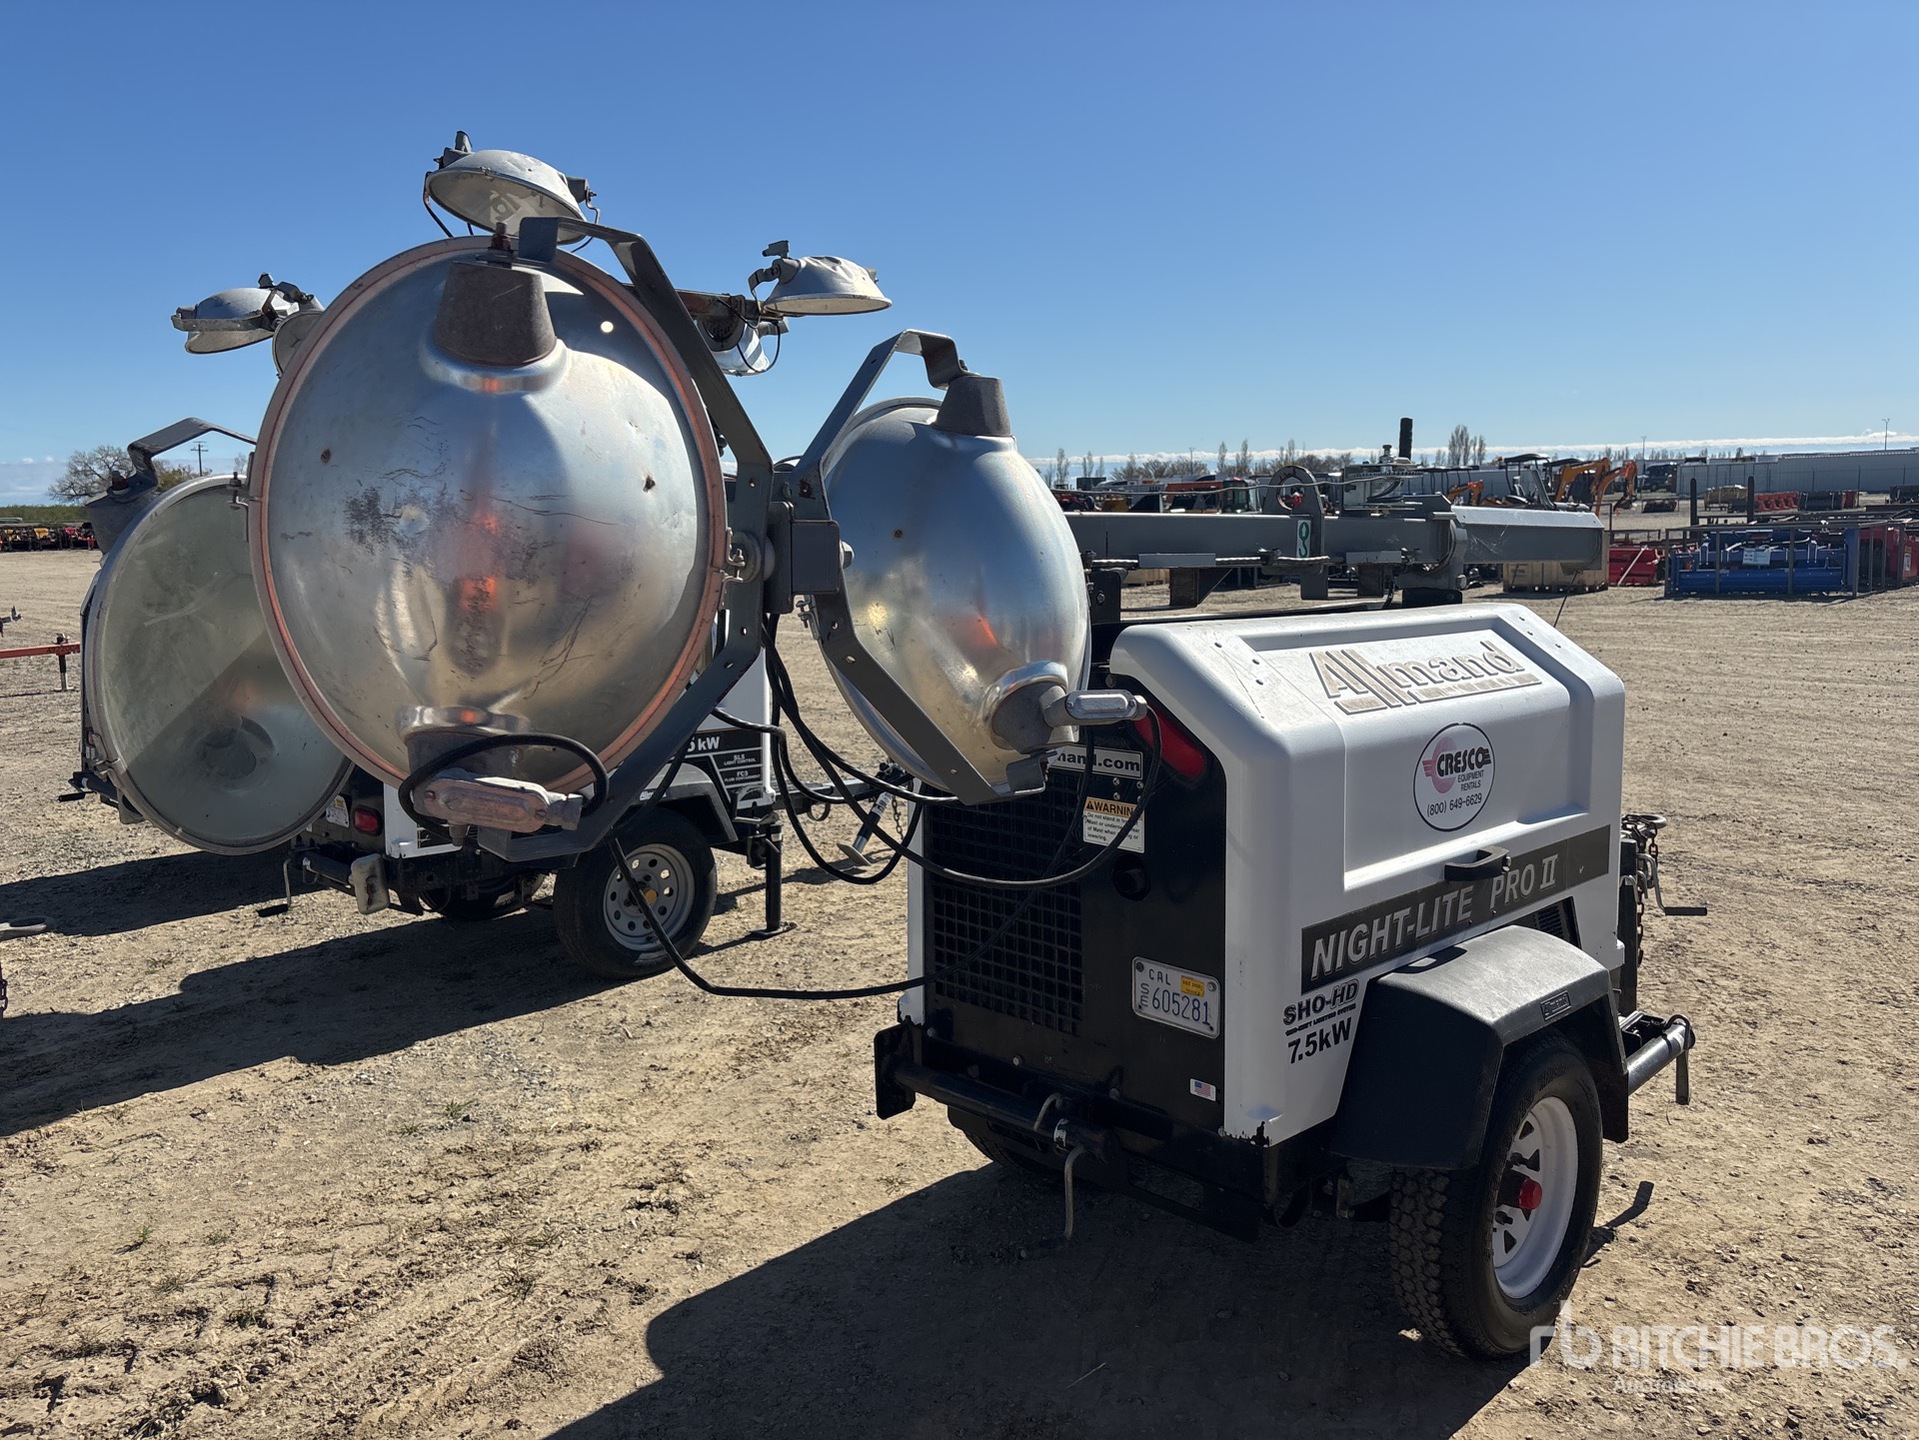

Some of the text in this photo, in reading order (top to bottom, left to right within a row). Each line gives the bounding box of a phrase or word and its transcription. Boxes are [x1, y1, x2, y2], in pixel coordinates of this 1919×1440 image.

[1309, 640, 1525, 708] Allmand
[1437, 747, 1491, 777] CRESCO
[1458, 769, 1484, 783] EQUIPMENT
[1461, 780, 1482, 792] RENTALS
[1094, 801, 1134, 816] WARNIN
[1427, 793, 1483, 817] (800) 649-6629
[1311, 854, 1558, 981] NIGHT-LITE PRO II
[1148, 968, 1171, 986] CAL
[1152, 987, 1211, 1026] 605281
[1283, 978, 1359, 1025] SHO-HD
[1288, 1017, 1352, 1064] 7.5kW
